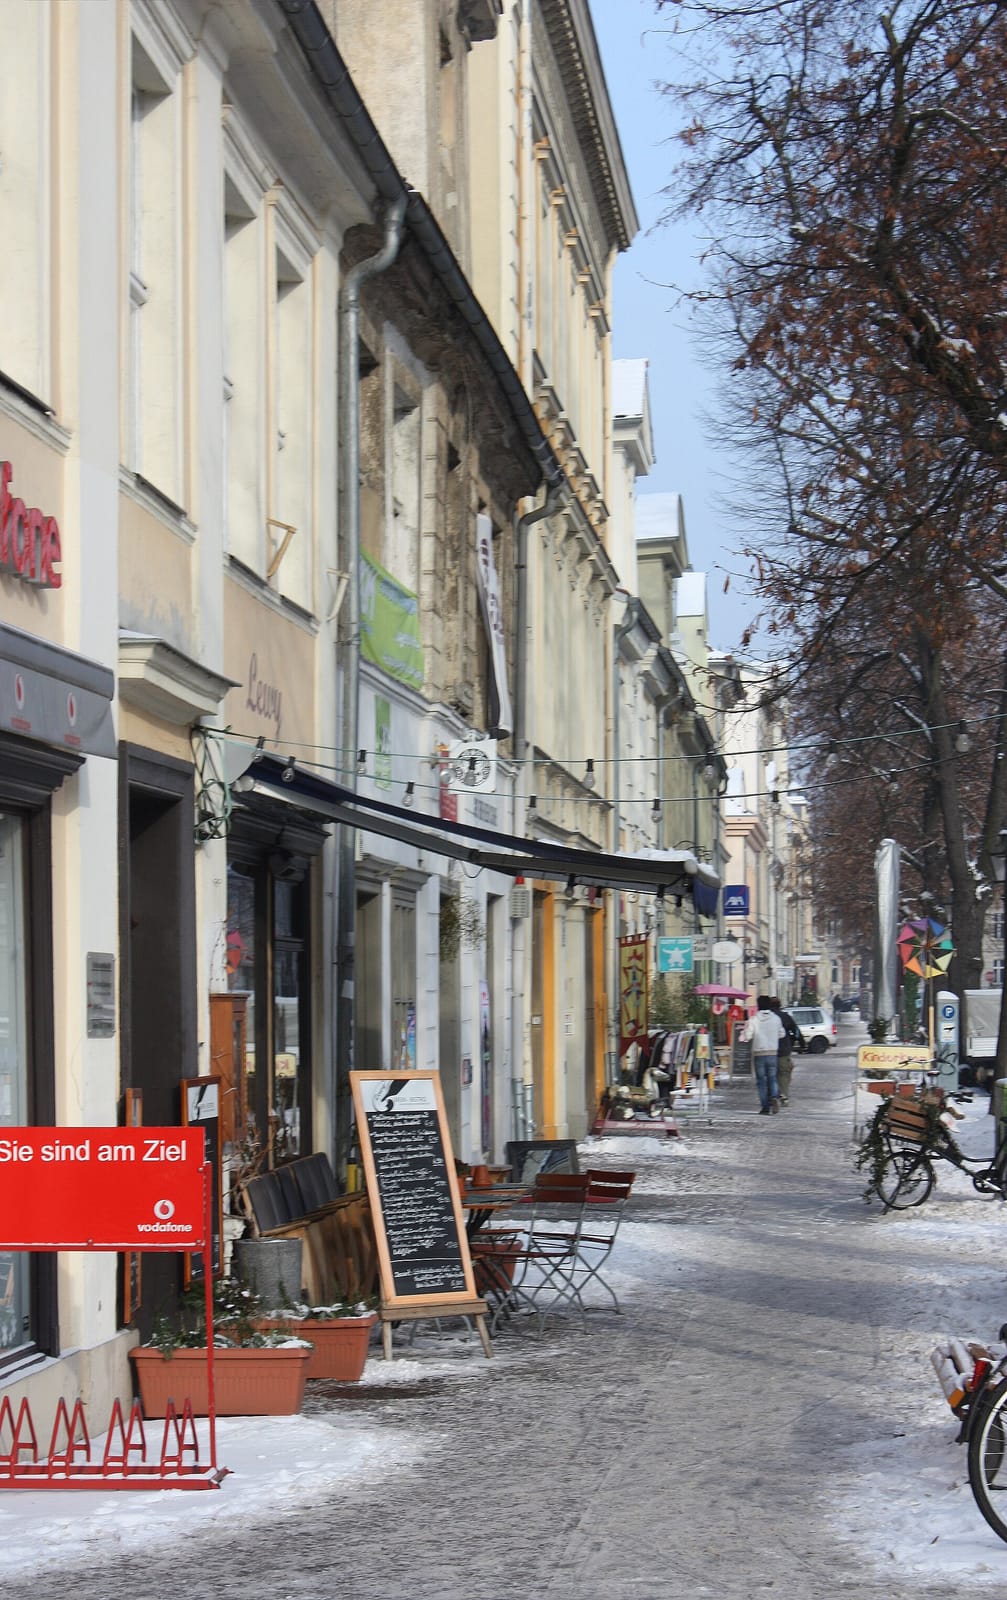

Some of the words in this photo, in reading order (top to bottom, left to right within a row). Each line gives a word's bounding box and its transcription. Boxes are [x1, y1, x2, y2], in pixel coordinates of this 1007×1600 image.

[725, 896, 745, 906] AXA
[945, 1007, 953, 1017] P
[0, 1140, 33, 1162] Sie
[41, 1139, 91, 1162] sind
[97, 1145, 136, 1162] am
[142, 1139, 187, 1162] Ziel
[137, 1221, 193, 1233] vodafone
